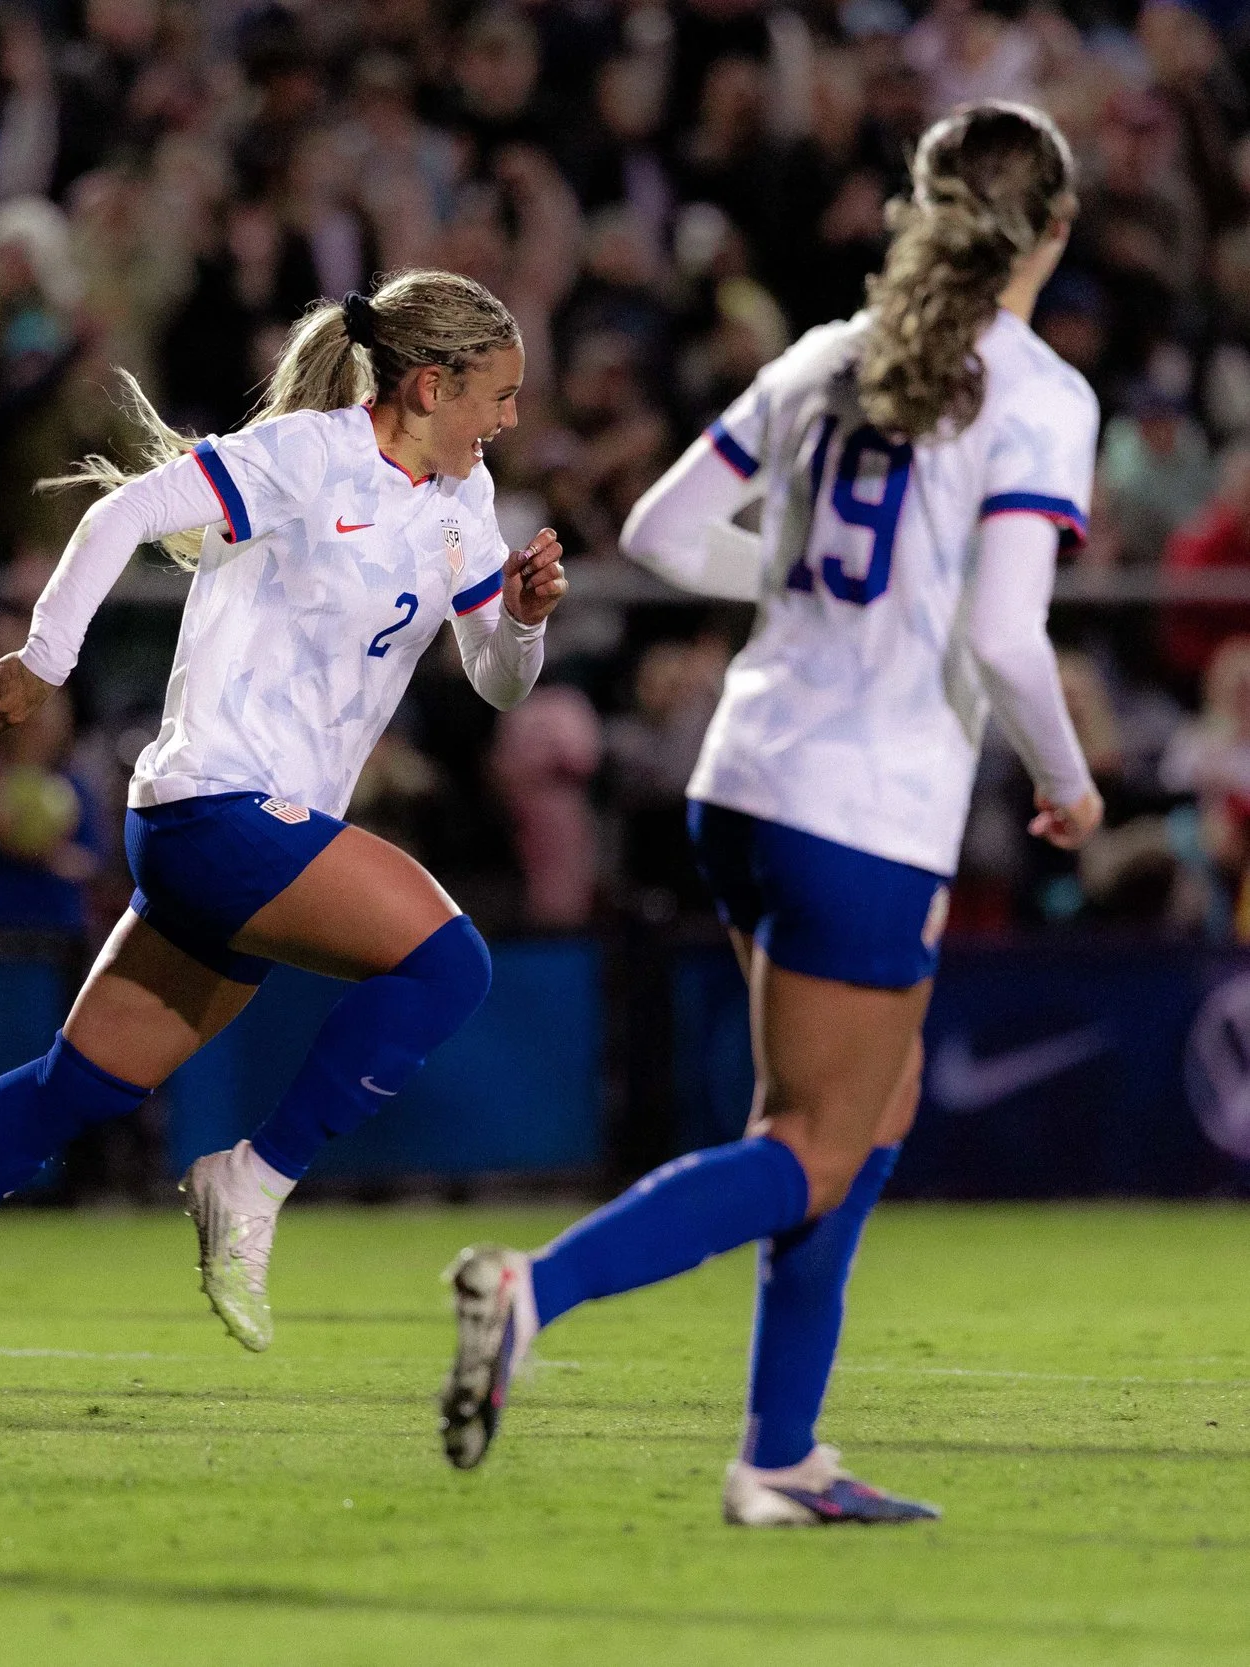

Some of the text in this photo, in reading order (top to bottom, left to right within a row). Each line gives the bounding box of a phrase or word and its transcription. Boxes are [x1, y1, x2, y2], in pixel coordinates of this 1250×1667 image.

[444, 529, 460, 547] USA
[786, 414, 913, 606] 19
[367, 592, 419, 658] 2
